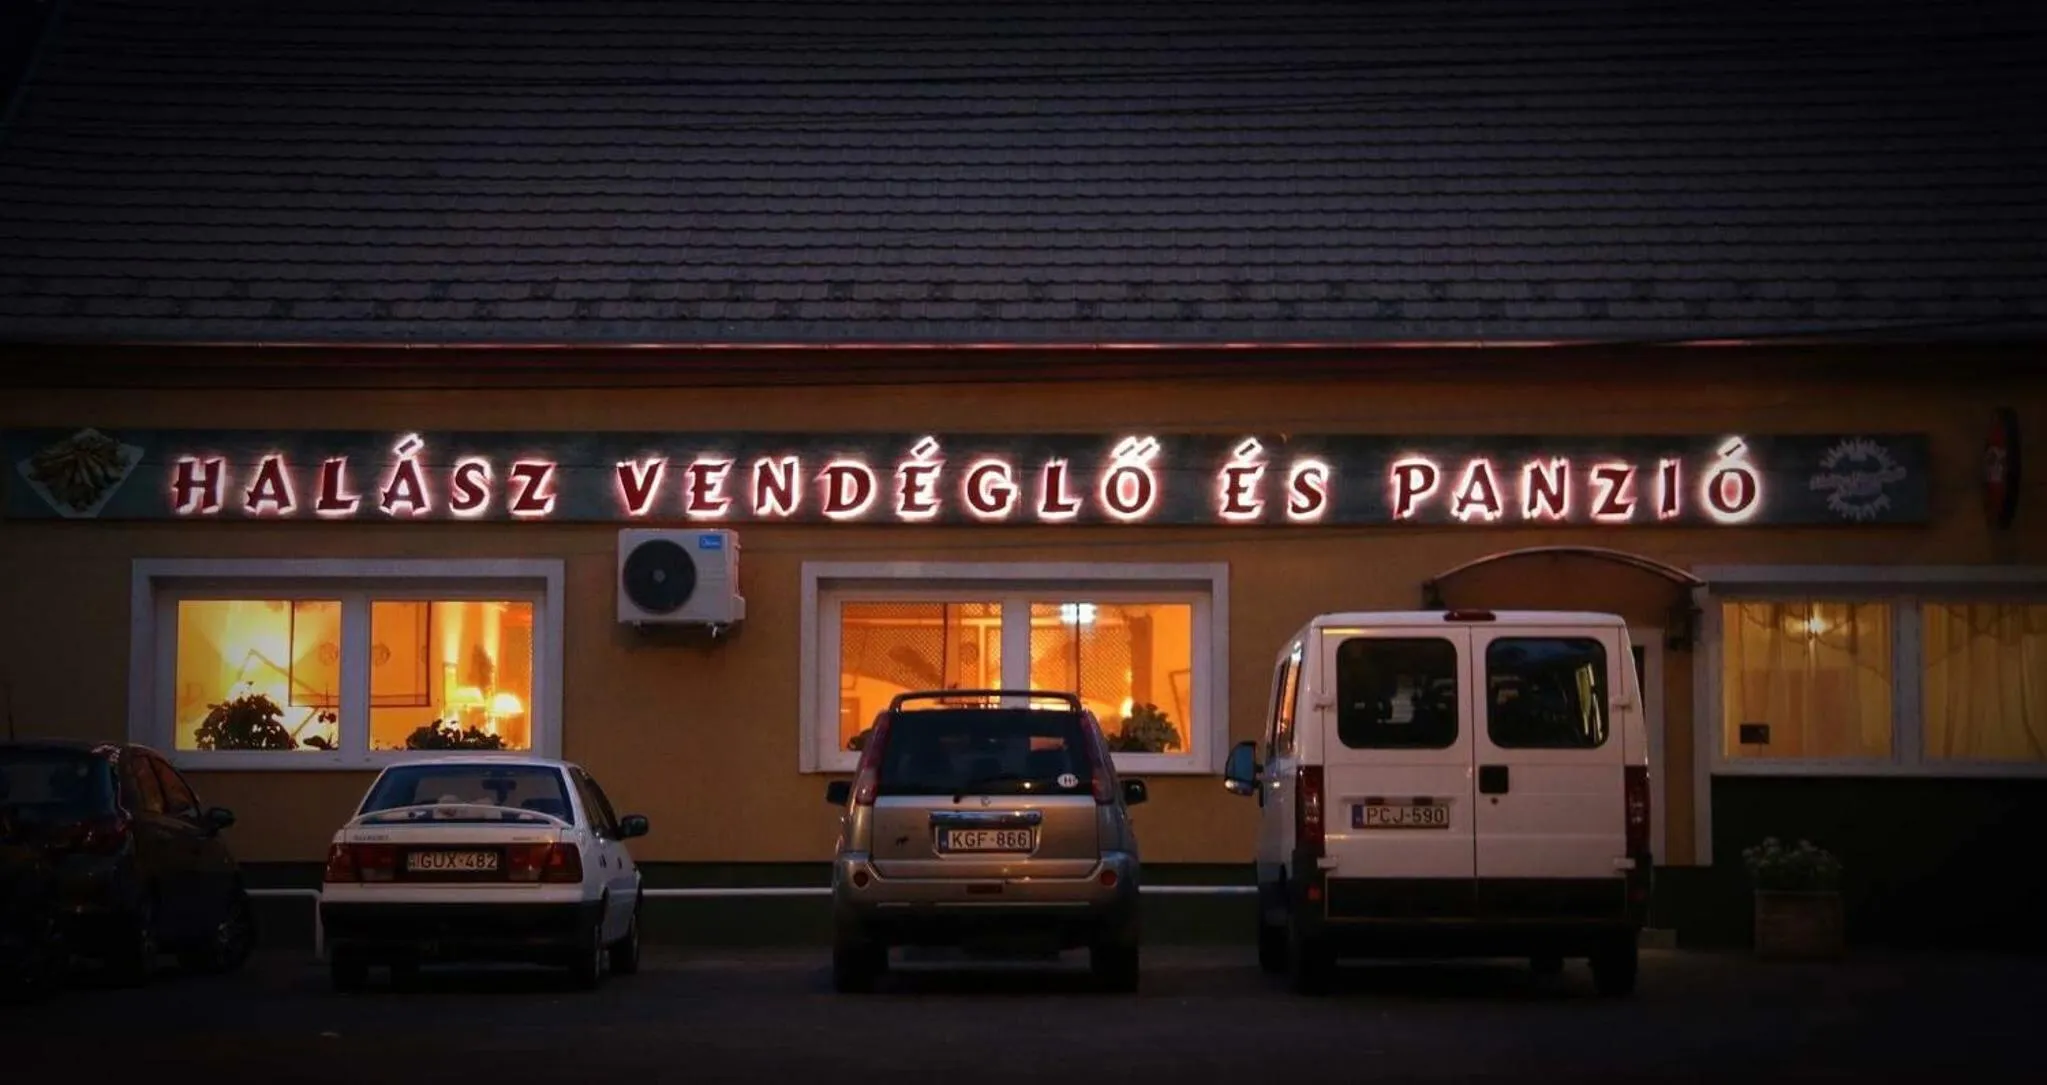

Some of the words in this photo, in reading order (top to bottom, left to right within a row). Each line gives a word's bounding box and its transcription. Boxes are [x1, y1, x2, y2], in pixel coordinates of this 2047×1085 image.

[172, 435, 559, 515] HALÁSZ
[616, 437, 1160, 519] VENDÉGLŐ
[1219, 438, 1329, 520] ÉS
[1391, 437, 1761, 522] PANZIÓ
[1366, 806, 1445, 824] PCJ-590
[952, 828, 1028, 849] KGF-866
[420, 852, 496, 869] GUX-482
